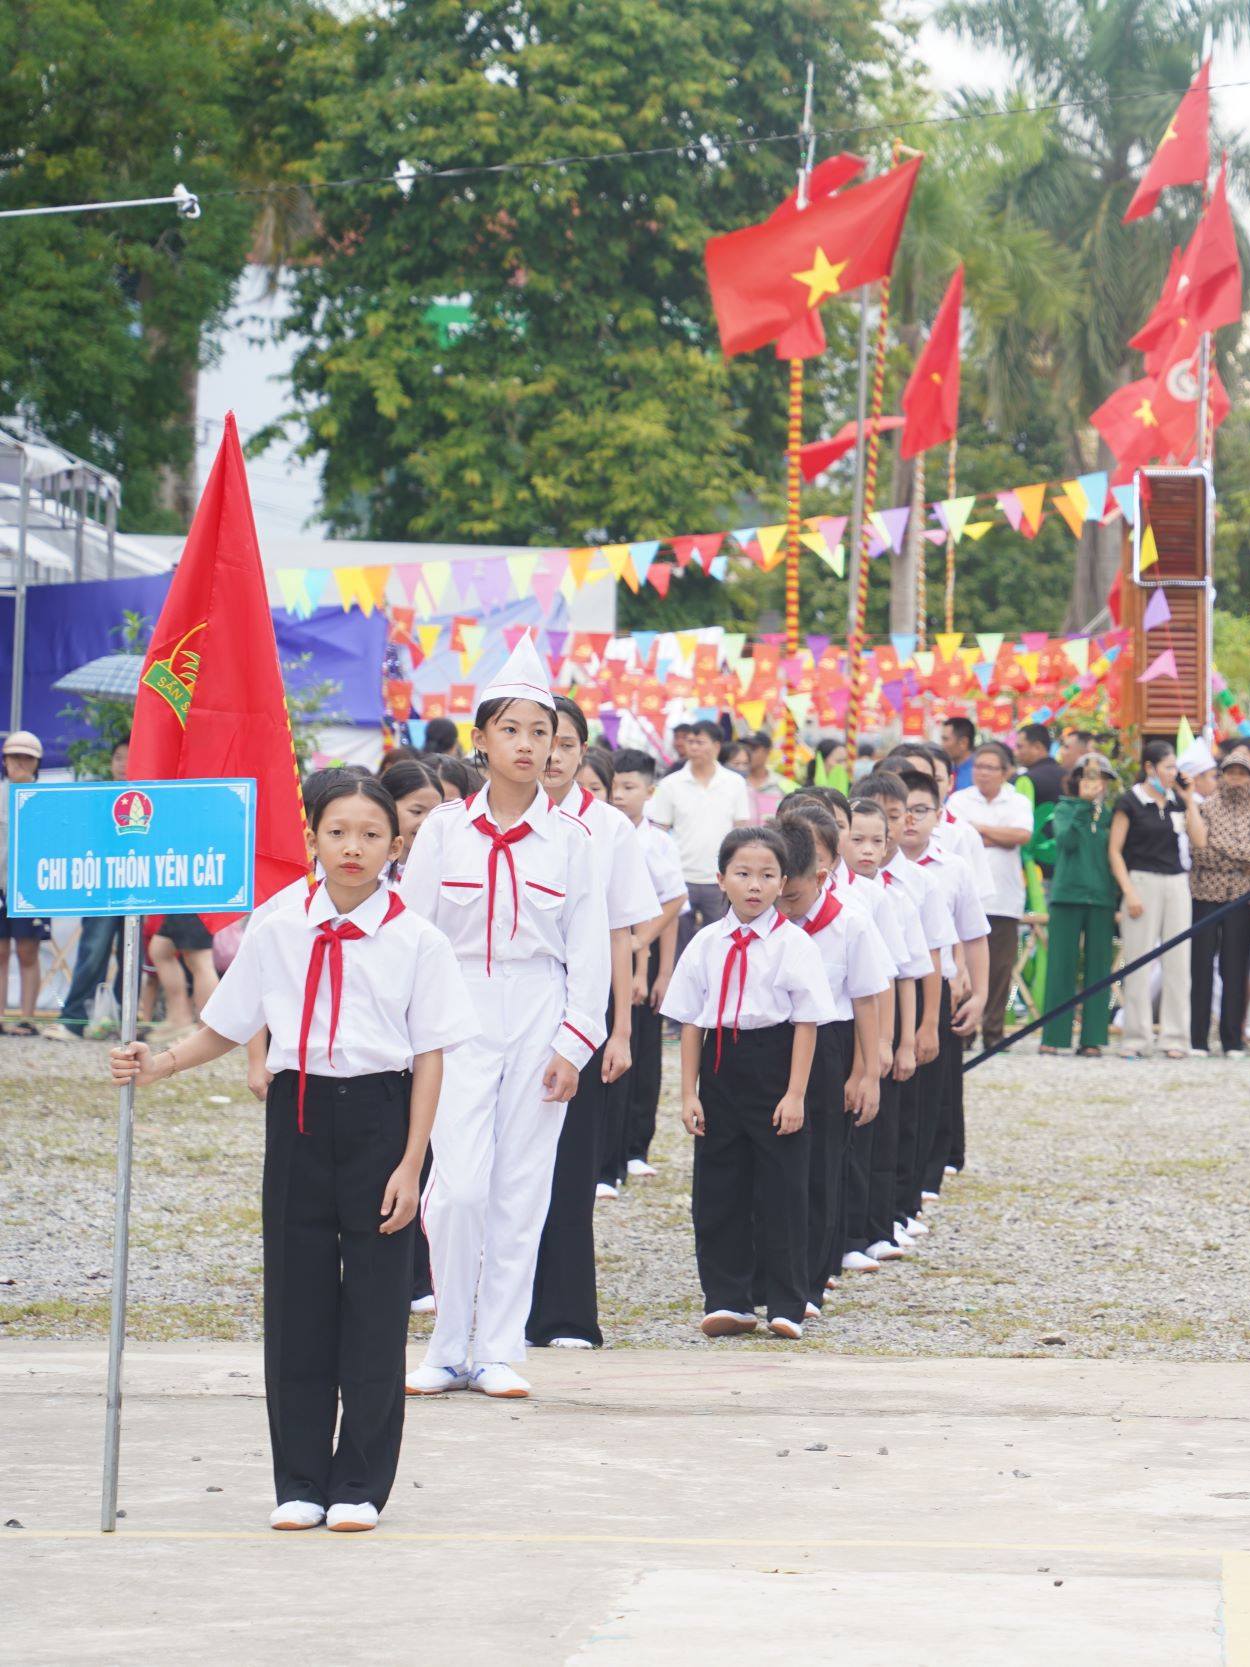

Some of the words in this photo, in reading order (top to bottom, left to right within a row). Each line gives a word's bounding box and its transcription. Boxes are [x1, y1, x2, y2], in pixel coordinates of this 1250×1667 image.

[37, 857, 67, 891] CHI
[71, 850, 100, 897] ĐỘI
[106, 849, 150, 889] THÔN
[155, 848, 189, 888] YÊN
[193, 847, 226, 886] CÁT
